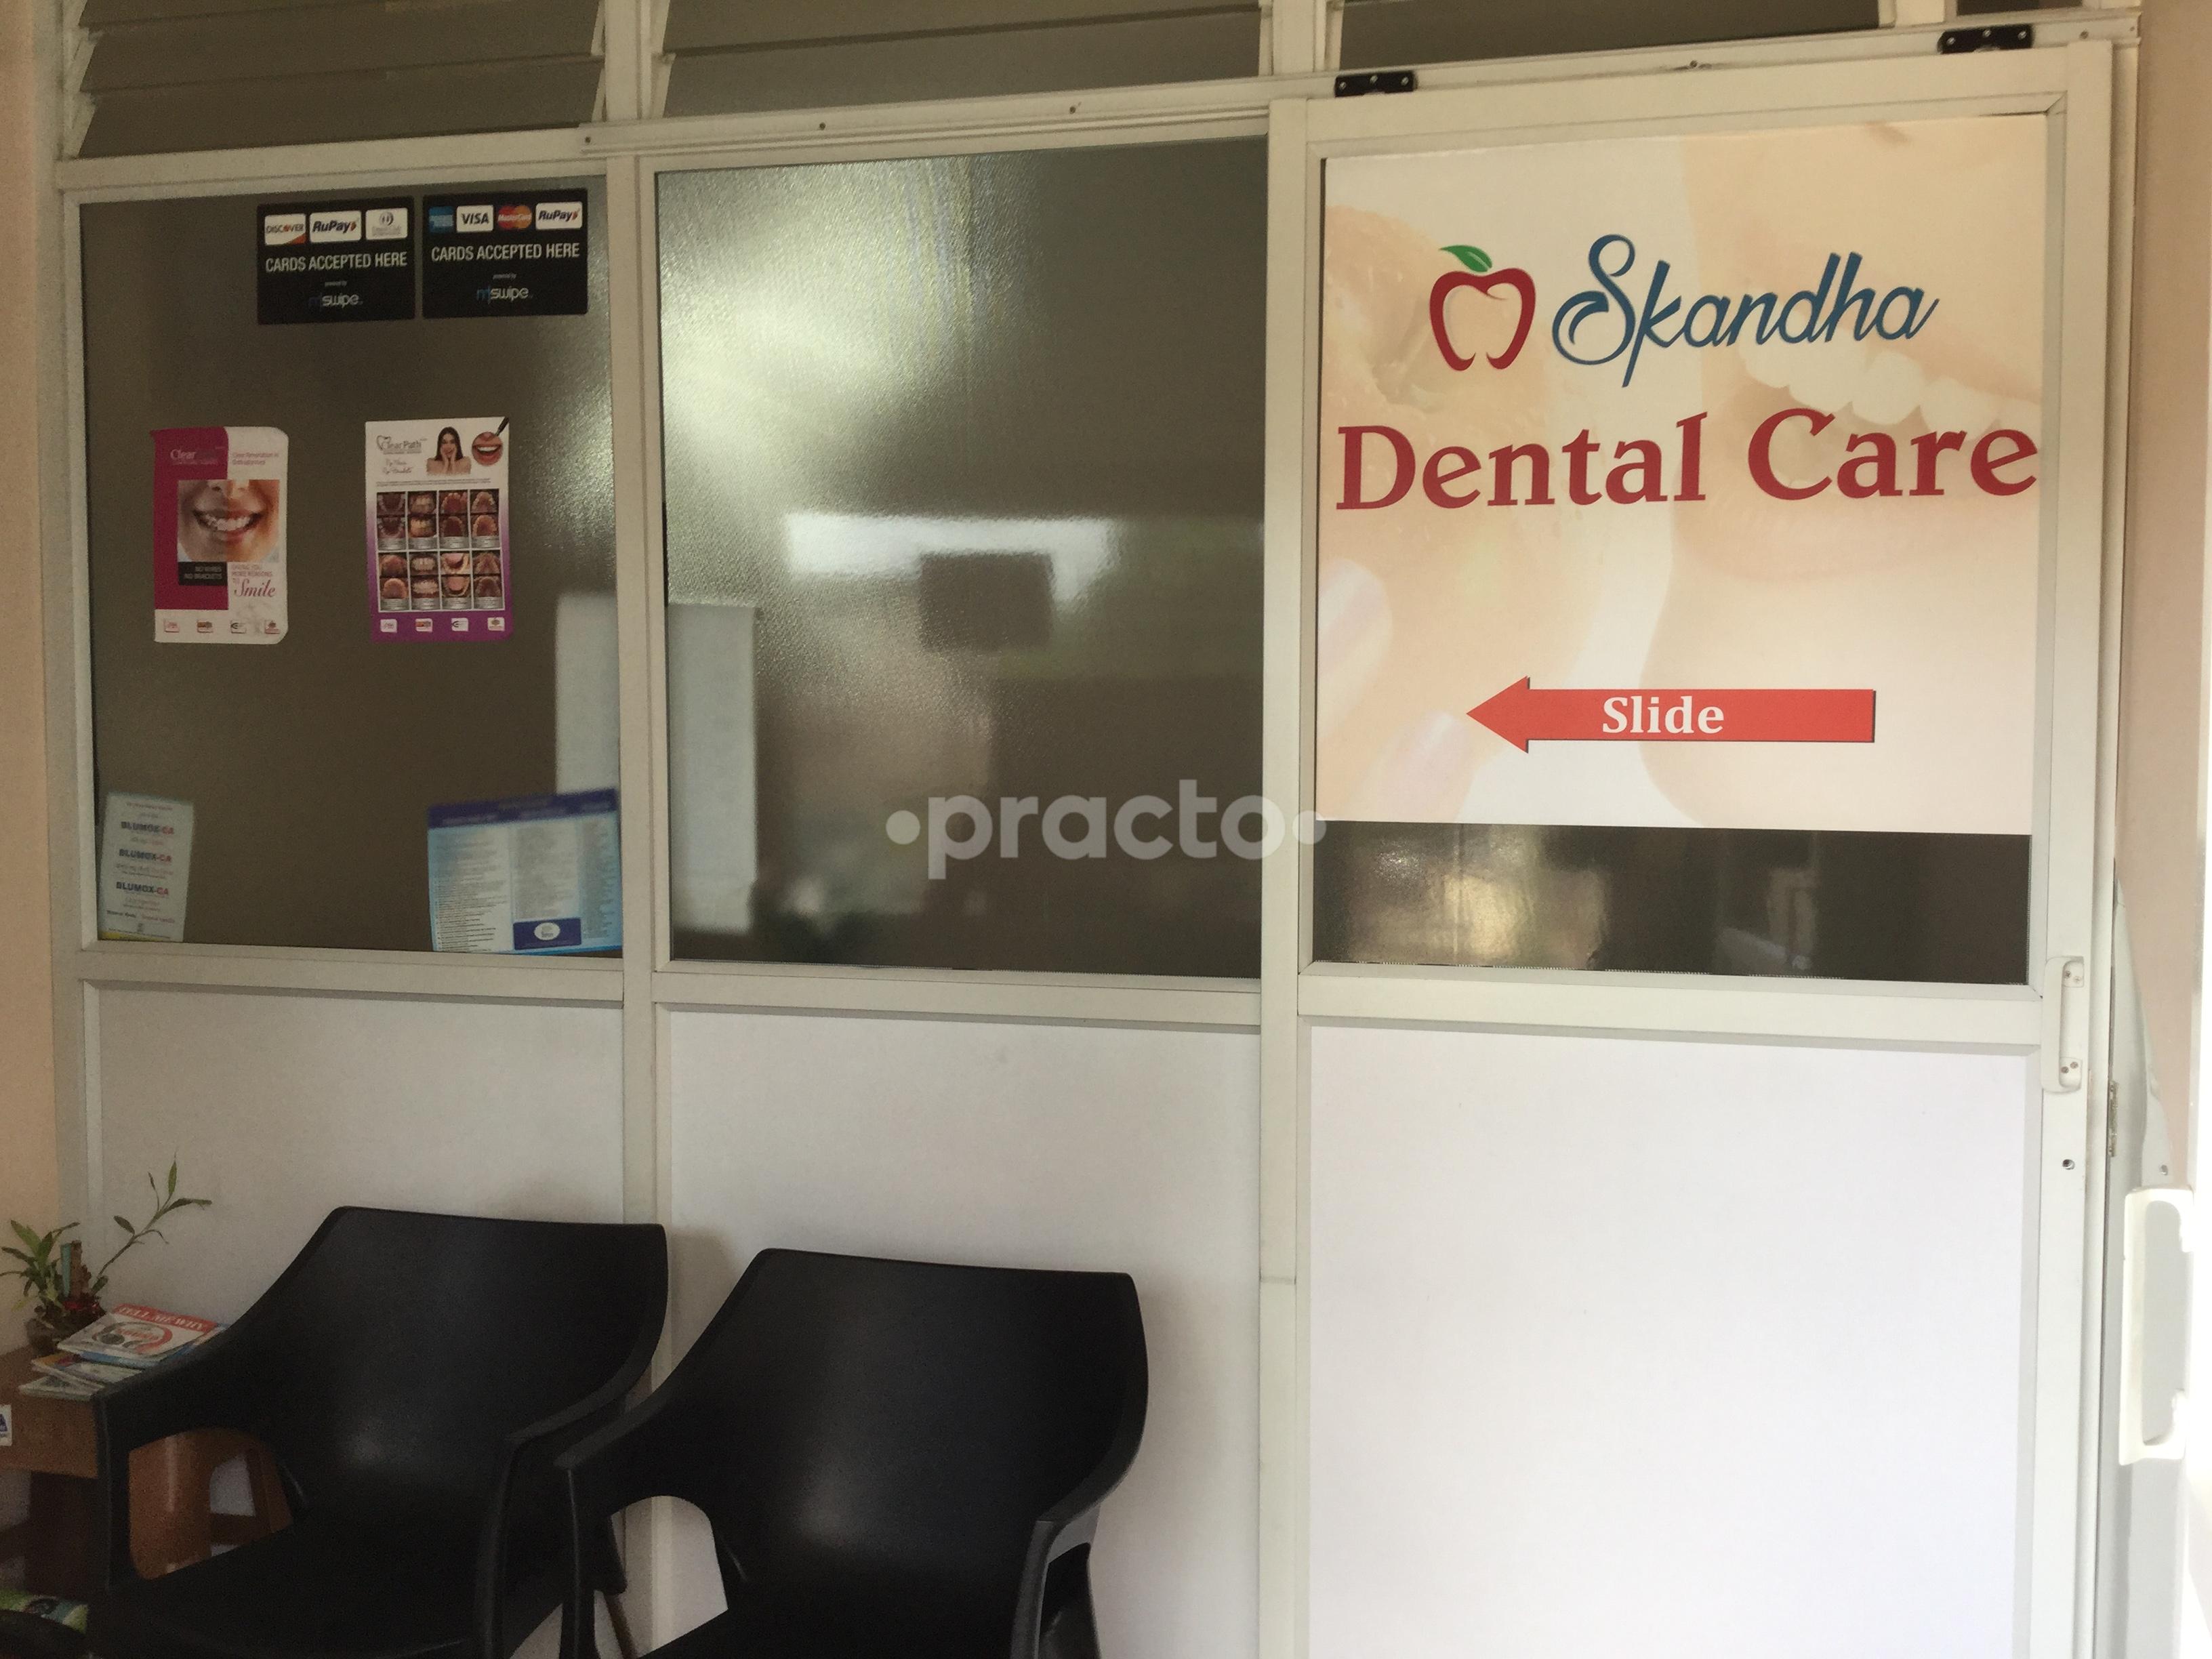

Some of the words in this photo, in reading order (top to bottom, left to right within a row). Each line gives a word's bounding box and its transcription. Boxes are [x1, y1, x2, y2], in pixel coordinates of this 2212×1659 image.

[461, 212, 490, 225] VISA
[538, 209, 573, 222] RuPay
[265, 222, 305, 234] DISCOVER
[312, 220, 348, 233] RuPay
[265, 256, 306, 272] CARDS
[308, 253, 371, 270] ACCEPTED
[375, 251, 408, 267] HERE
[431, 245, 474, 262] CARDS
[476, 243, 542, 260] ACCEPTED
[546, 242, 580, 259] HERE
[1552, 234, 1940, 388] Skandha
[1336, 411, 1708, 510] Dental
[1746, 407, 2037, 502] Care
[234, 578, 276, 598] Smile
[1602, 696, 1724, 735] Slide
[116, 881, 169, 895] BLUMOX-CA
